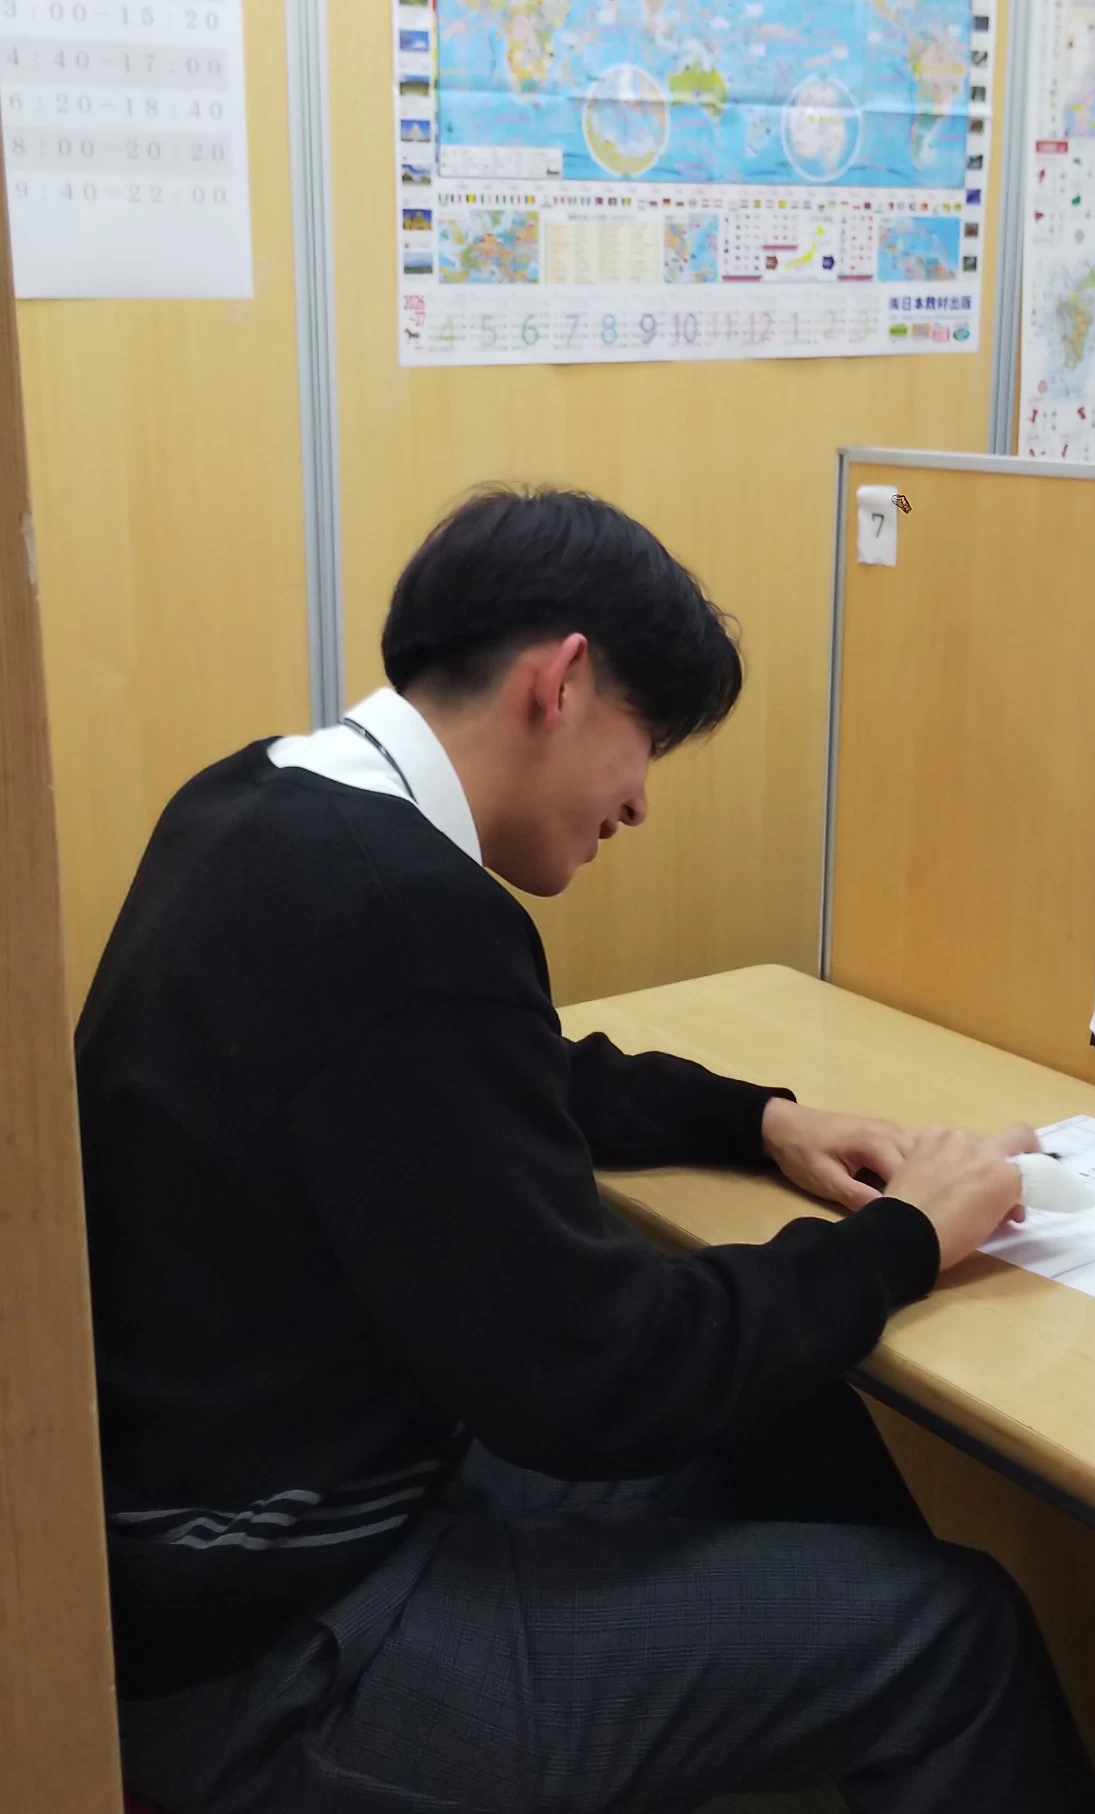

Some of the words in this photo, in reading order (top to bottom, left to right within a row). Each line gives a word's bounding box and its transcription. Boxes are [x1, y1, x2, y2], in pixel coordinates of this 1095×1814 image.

[439, 313, 456, 342] 4
[481, 315, 498, 346] 5
[521, 313, 540, 346] 6
[564, 314, 580, 346] 7
[601, 313, 618, 345] 8
[639, 313, 658, 345] 9
[674, 313, 701, 344] 10
[749, 311, 777, 342] 12
[871, 512, 885, 539] 7
